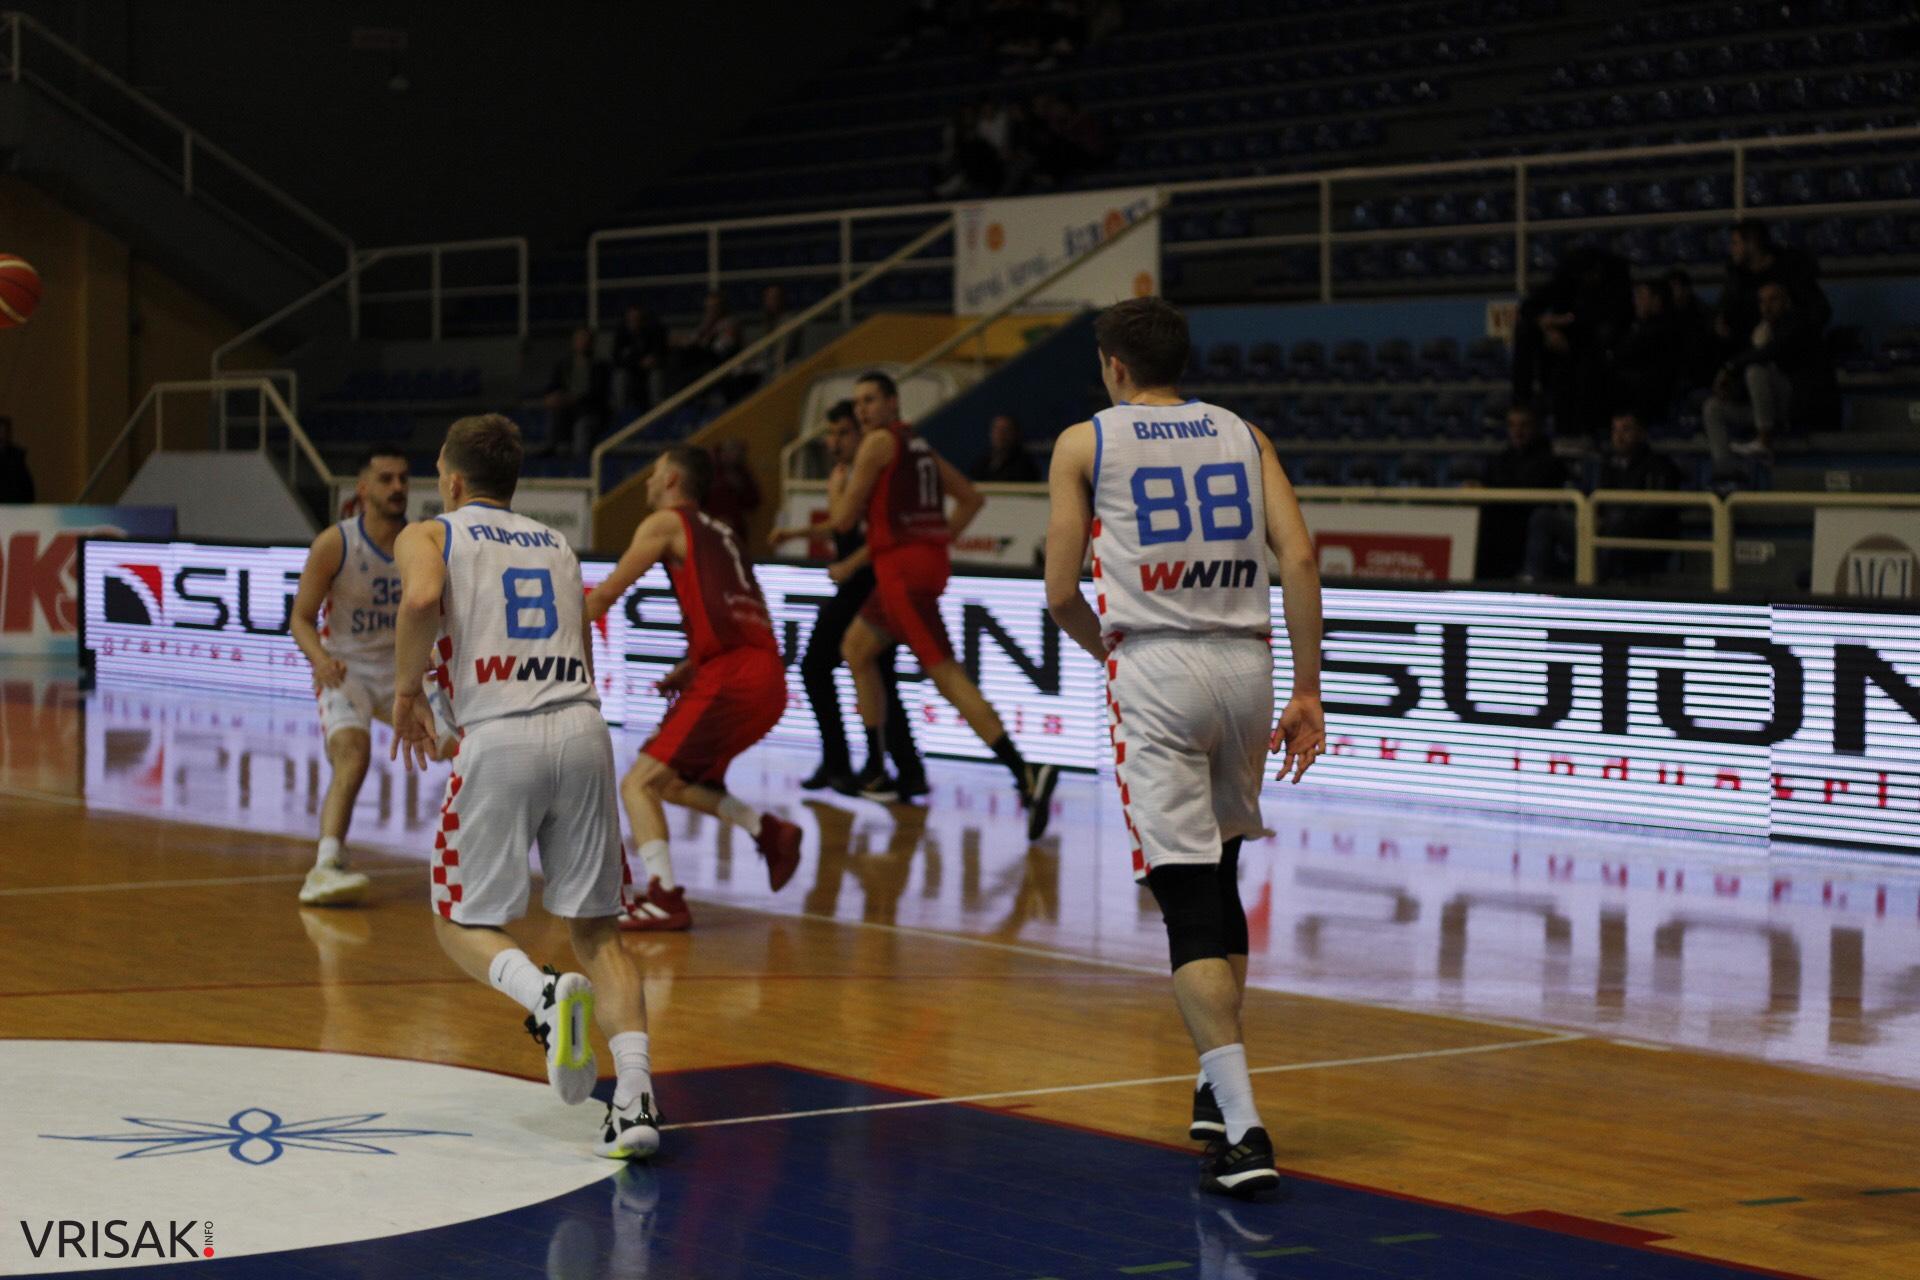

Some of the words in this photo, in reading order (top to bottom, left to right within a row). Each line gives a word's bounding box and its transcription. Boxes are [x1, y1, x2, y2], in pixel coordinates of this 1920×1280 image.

[1133, 413, 1218, 440] BATINIĆ
[1130, 462, 1253, 546] 88
[468, 524, 559, 550] FILIPOVIĆ
[501, 567, 559, 640] 8
